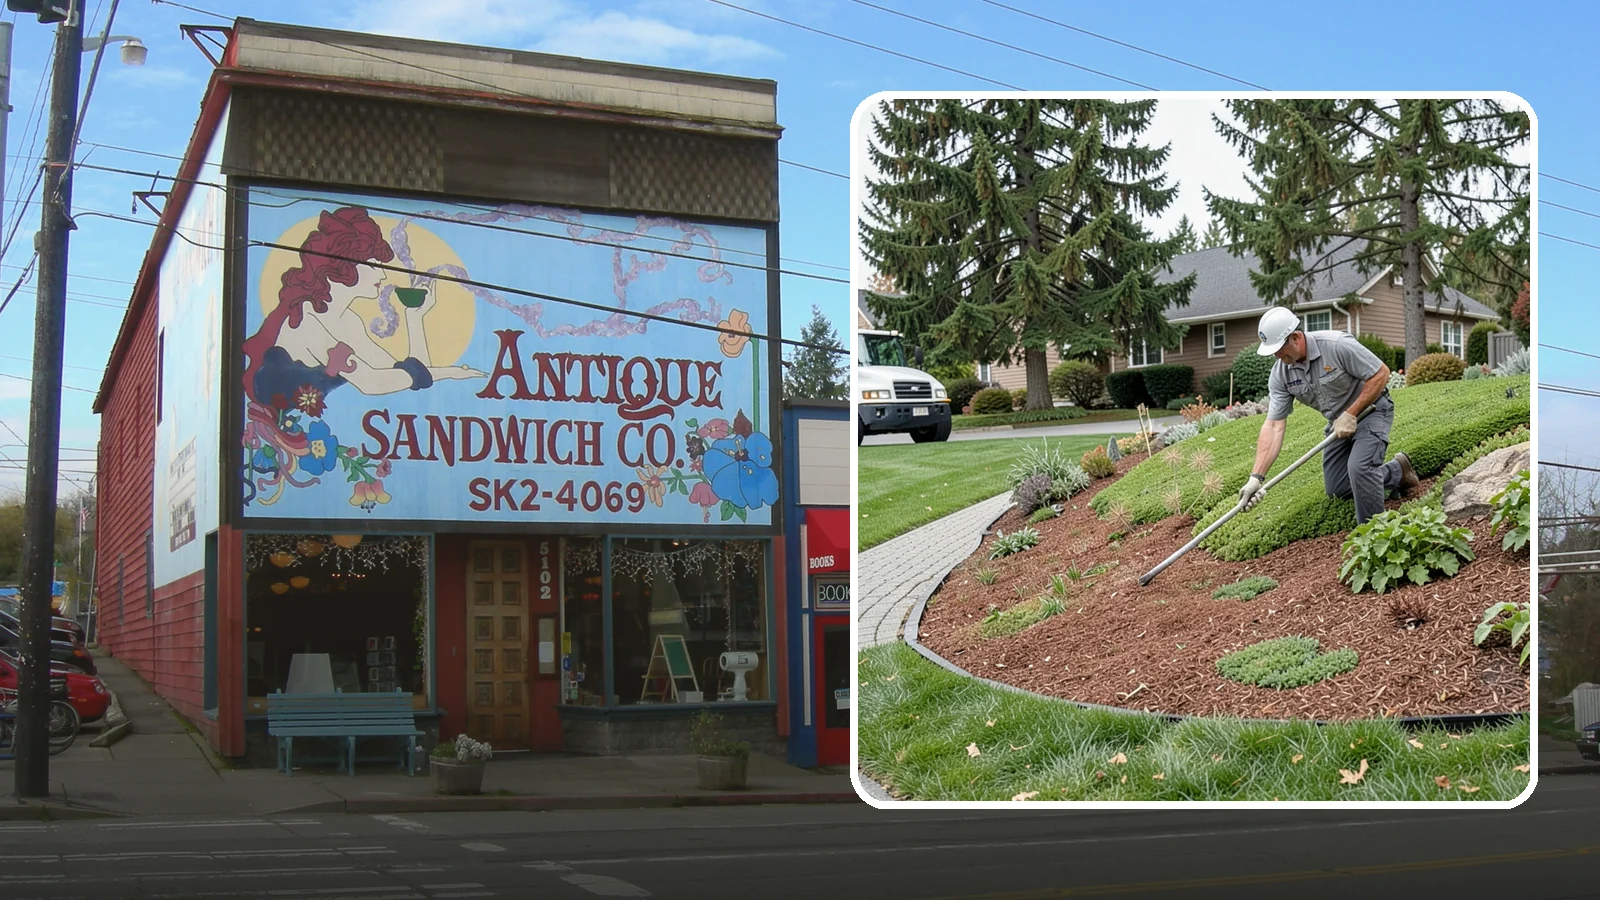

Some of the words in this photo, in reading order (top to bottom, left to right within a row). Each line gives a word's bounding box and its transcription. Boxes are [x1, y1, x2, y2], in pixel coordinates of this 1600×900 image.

[475, 329, 724, 421] ANTIQUE
[361, 408, 605, 468] SANDWICH
[617, 422, 685, 469] CO.
[469, 477, 646, 513] SK2-4069
[540, 541, 552, 600] 5102
[809, 555, 835, 569] BOOKS
